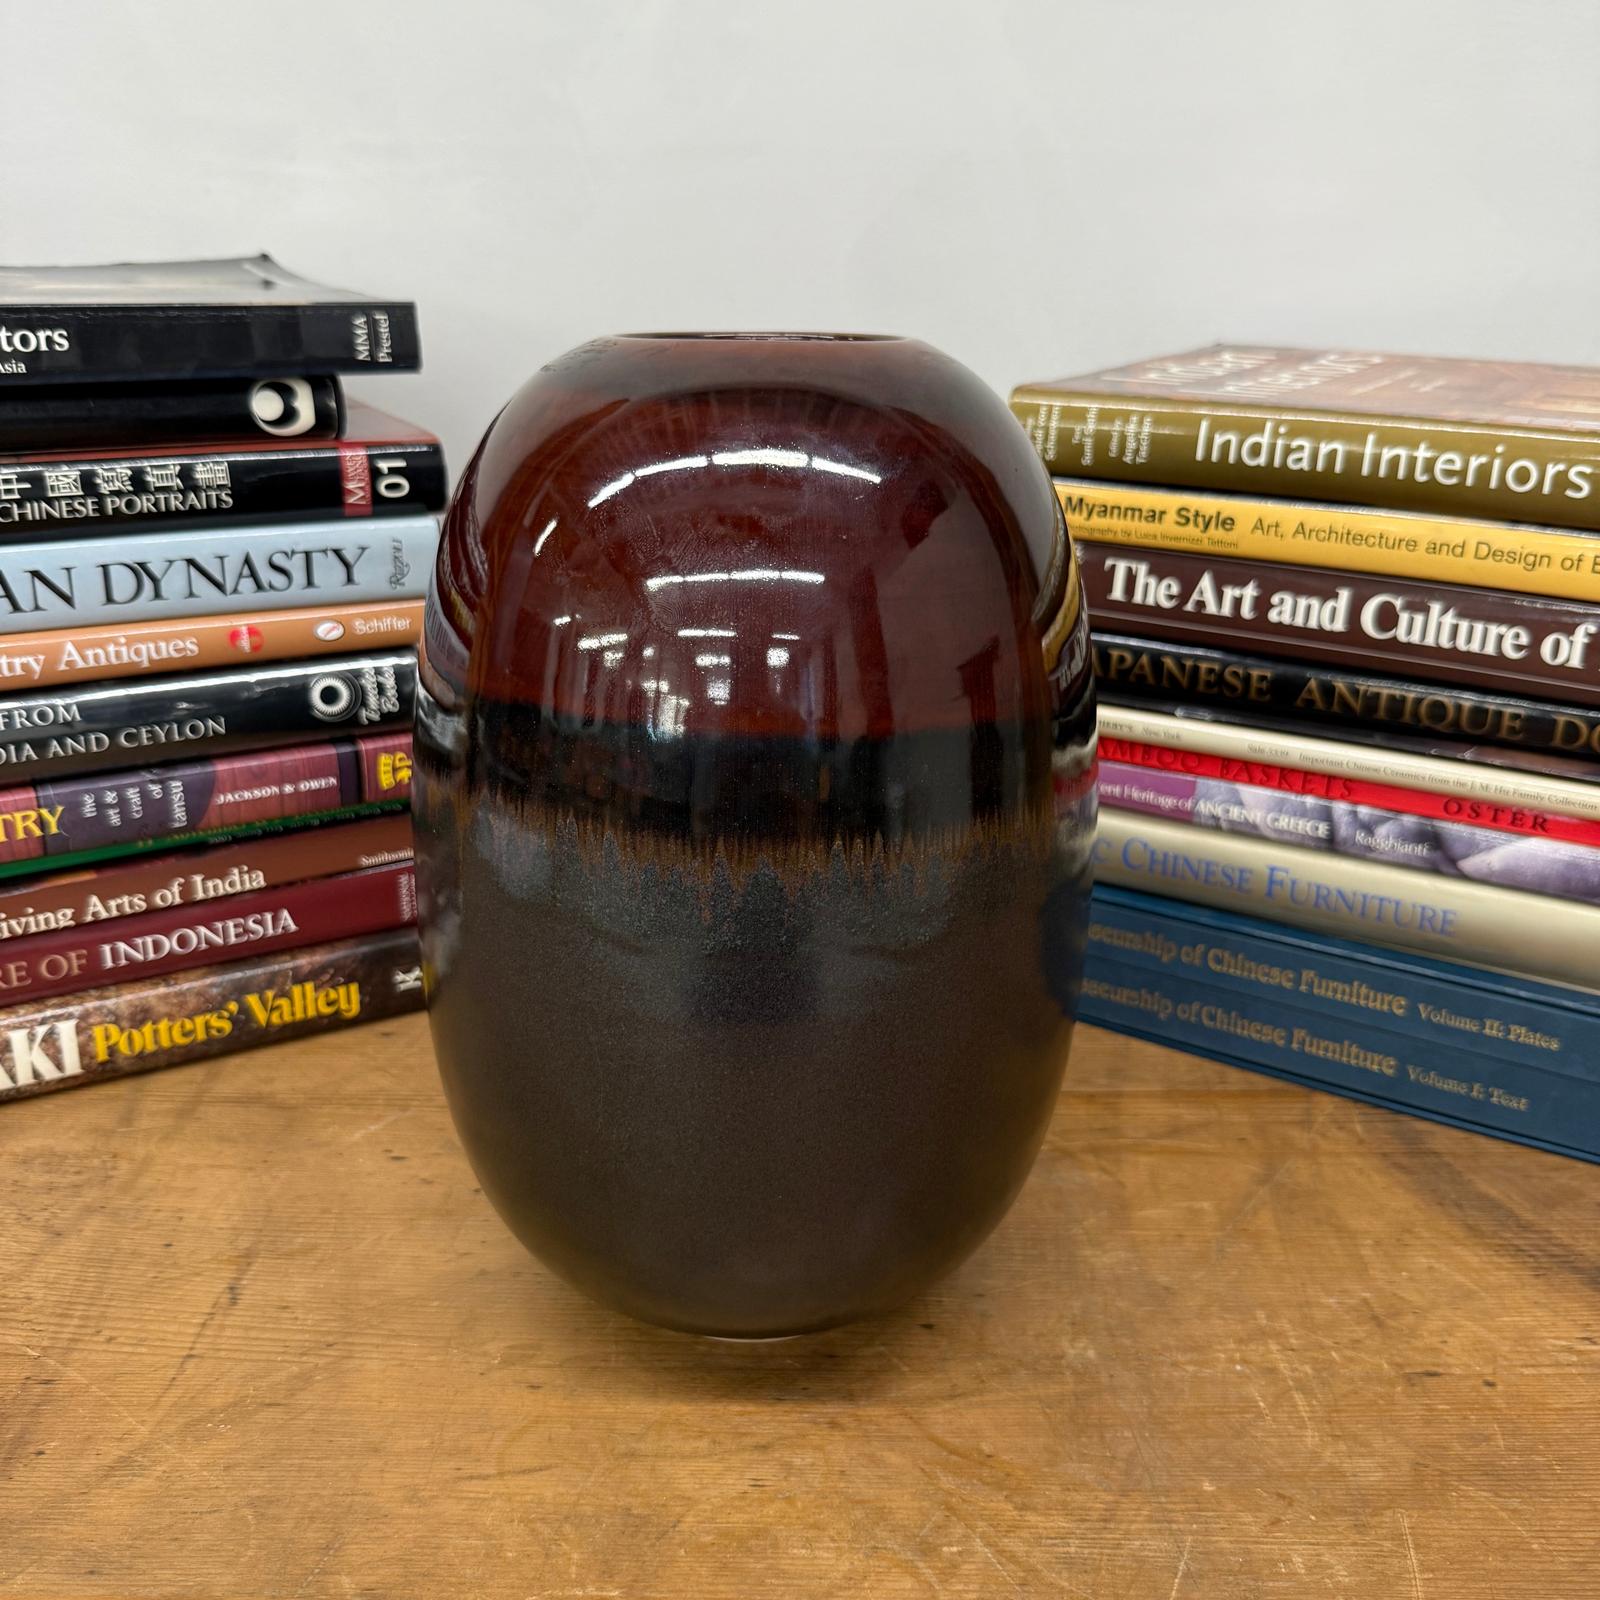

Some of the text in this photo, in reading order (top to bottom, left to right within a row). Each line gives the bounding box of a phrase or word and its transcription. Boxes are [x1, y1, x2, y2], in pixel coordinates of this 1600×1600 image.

[0, 325, 70, 352] tors
[351, 311, 371, 361] MMA
[373, 309, 393, 362] Prestel
[375, 458, 410, 498] 01
[1195, 416, 1595, 500] Indian Interiors
[0, 488, 233, 522] CHINESE PORTRAITS
[1065, 497, 1236, 533] Myanmar Style
[1251, 516, 1284, 541] Art,
[1291, 521, 1419, 553] Architecture
[1425, 539, 1467, 559] and
[1473, 541, 1552, 573] Design
[1560, 553, 1585, 573] of
[96, 547, 371, 607] DYNASTY
[353, 615, 413, 635] Schiffer
[1104, 556, 1599, 669] The Art and Culture of
[56, 636, 200, 671] Antiques
[0, 703, 82, 731] FROM
[1296, 675, 1526, 741] ANTIQUE
[48, 731, 110, 758] AND
[114, 715, 227, 748] CEYLON
[0, 776, 337, 843] TRY JACKSON & OWEN
[1124, 783, 1178, 811] Heritage
[1178, 796, 1193, 811] of
[1194, 800, 1263, 824] ANCIENT
[1267, 811, 1332, 839] GREECE
[1443, 798, 1550, 833] OSTER
[82, 894, 148, 923] Arts
[154, 877, 186, 908] of
[190, 864, 267, 902] India
[1121, 836, 1253, 892] CHINESE
[1265, 864, 1457, 937] FURNITURE
[39, 949, 88, 980] OF
[98, 908, 299, 970] INDONESIA
[91, 1001, 240, 1063] Potters'
[245, 981, 361, 1029] Valley
[1180, 943, 1206, 967] of
[1207, 948, 1295, 989] Chinese
[1299, 968, 1408, 1017] Furniture
[1417, 1002, 1481, 1033] Volume
[1507, 1024, 1561, 1051] Plates
[1176, 1000, 1201, 1024] of
[1201, 1005, 1287, 1047] Chinese
[1291, 1026, 1399, 1077] Furniture
[1406, 1065, 1469, 1095] Volume
[1488, 1087, 1531, 1112] Text
